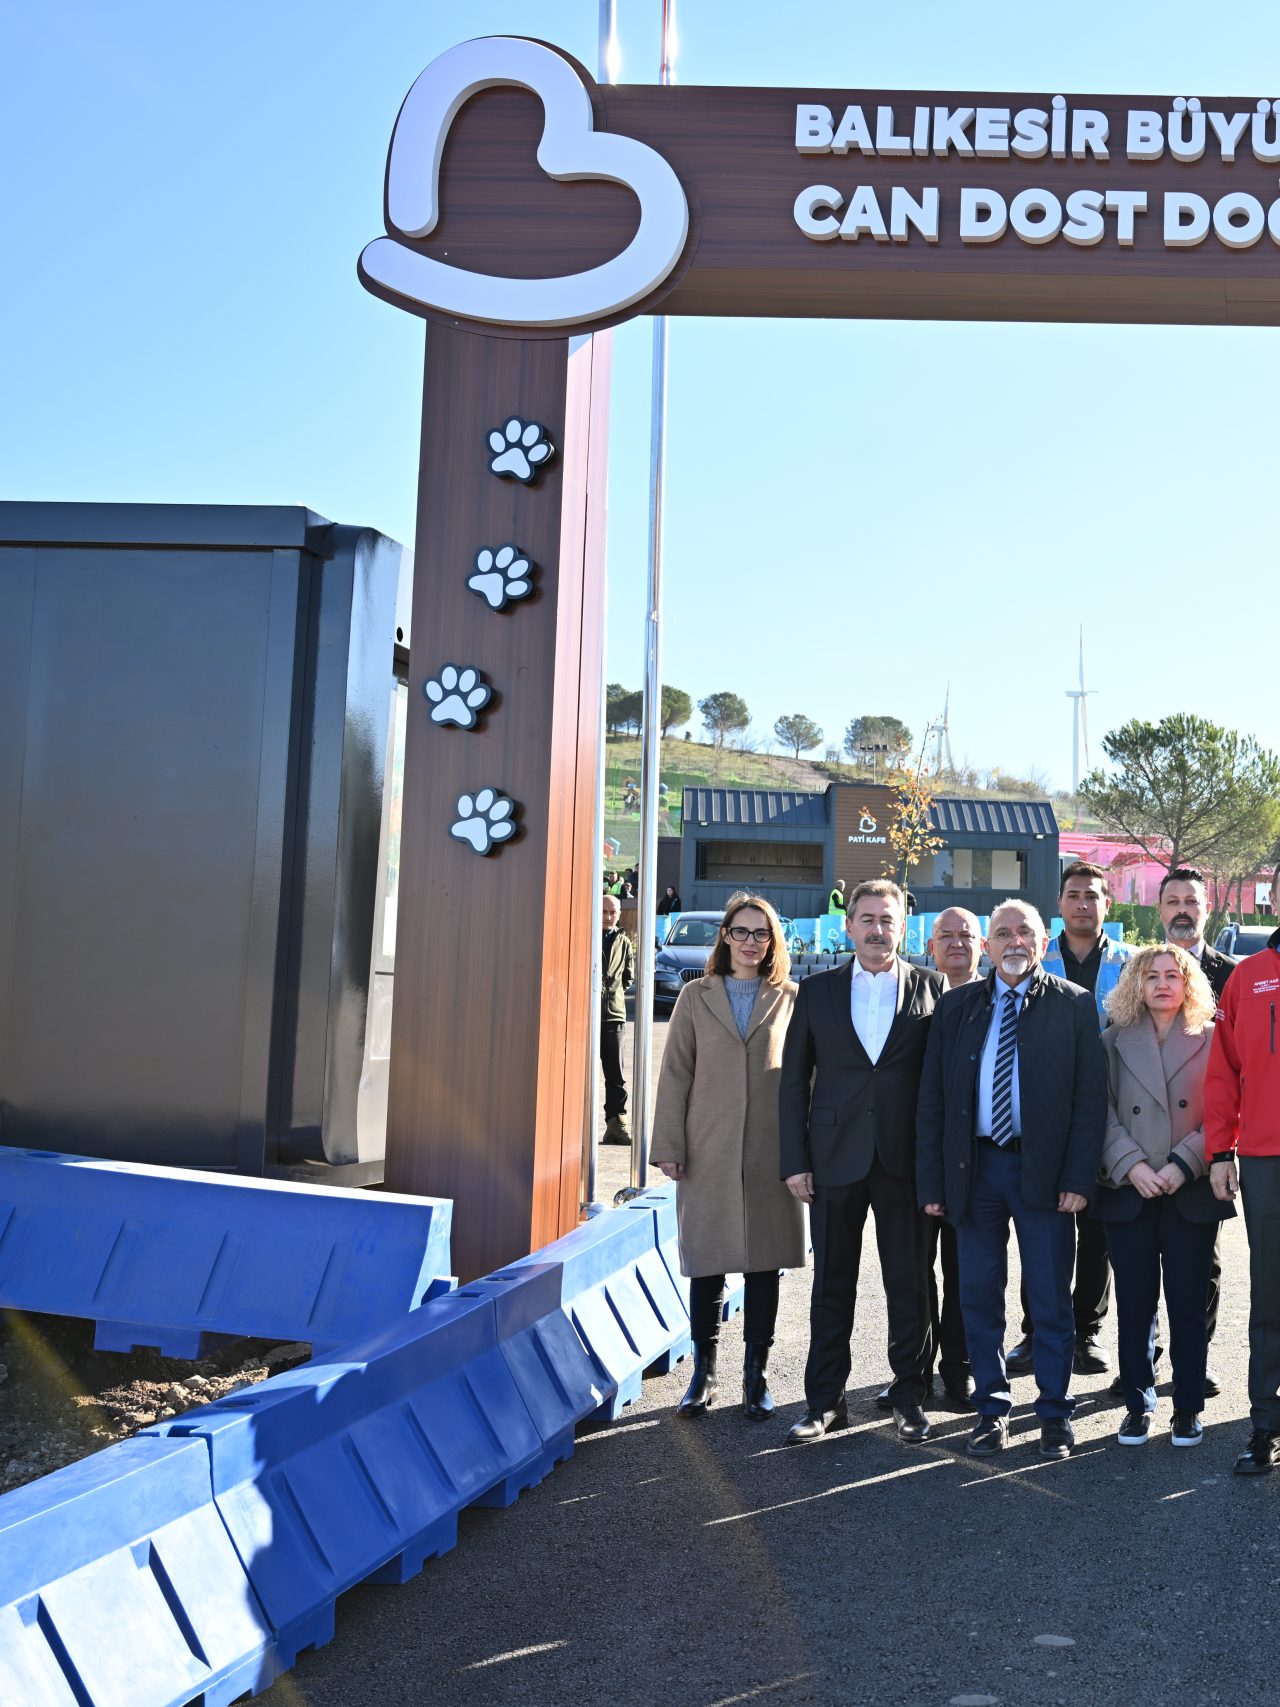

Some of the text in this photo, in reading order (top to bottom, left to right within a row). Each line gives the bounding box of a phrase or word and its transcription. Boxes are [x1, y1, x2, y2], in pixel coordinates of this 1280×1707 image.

[795, 95, 1110, 160] BALIKESİR
[793, 184, 940, 242] CAN
[959, 187, 1148, 247] DOST
[848, 835, 865, 843] PATİ
